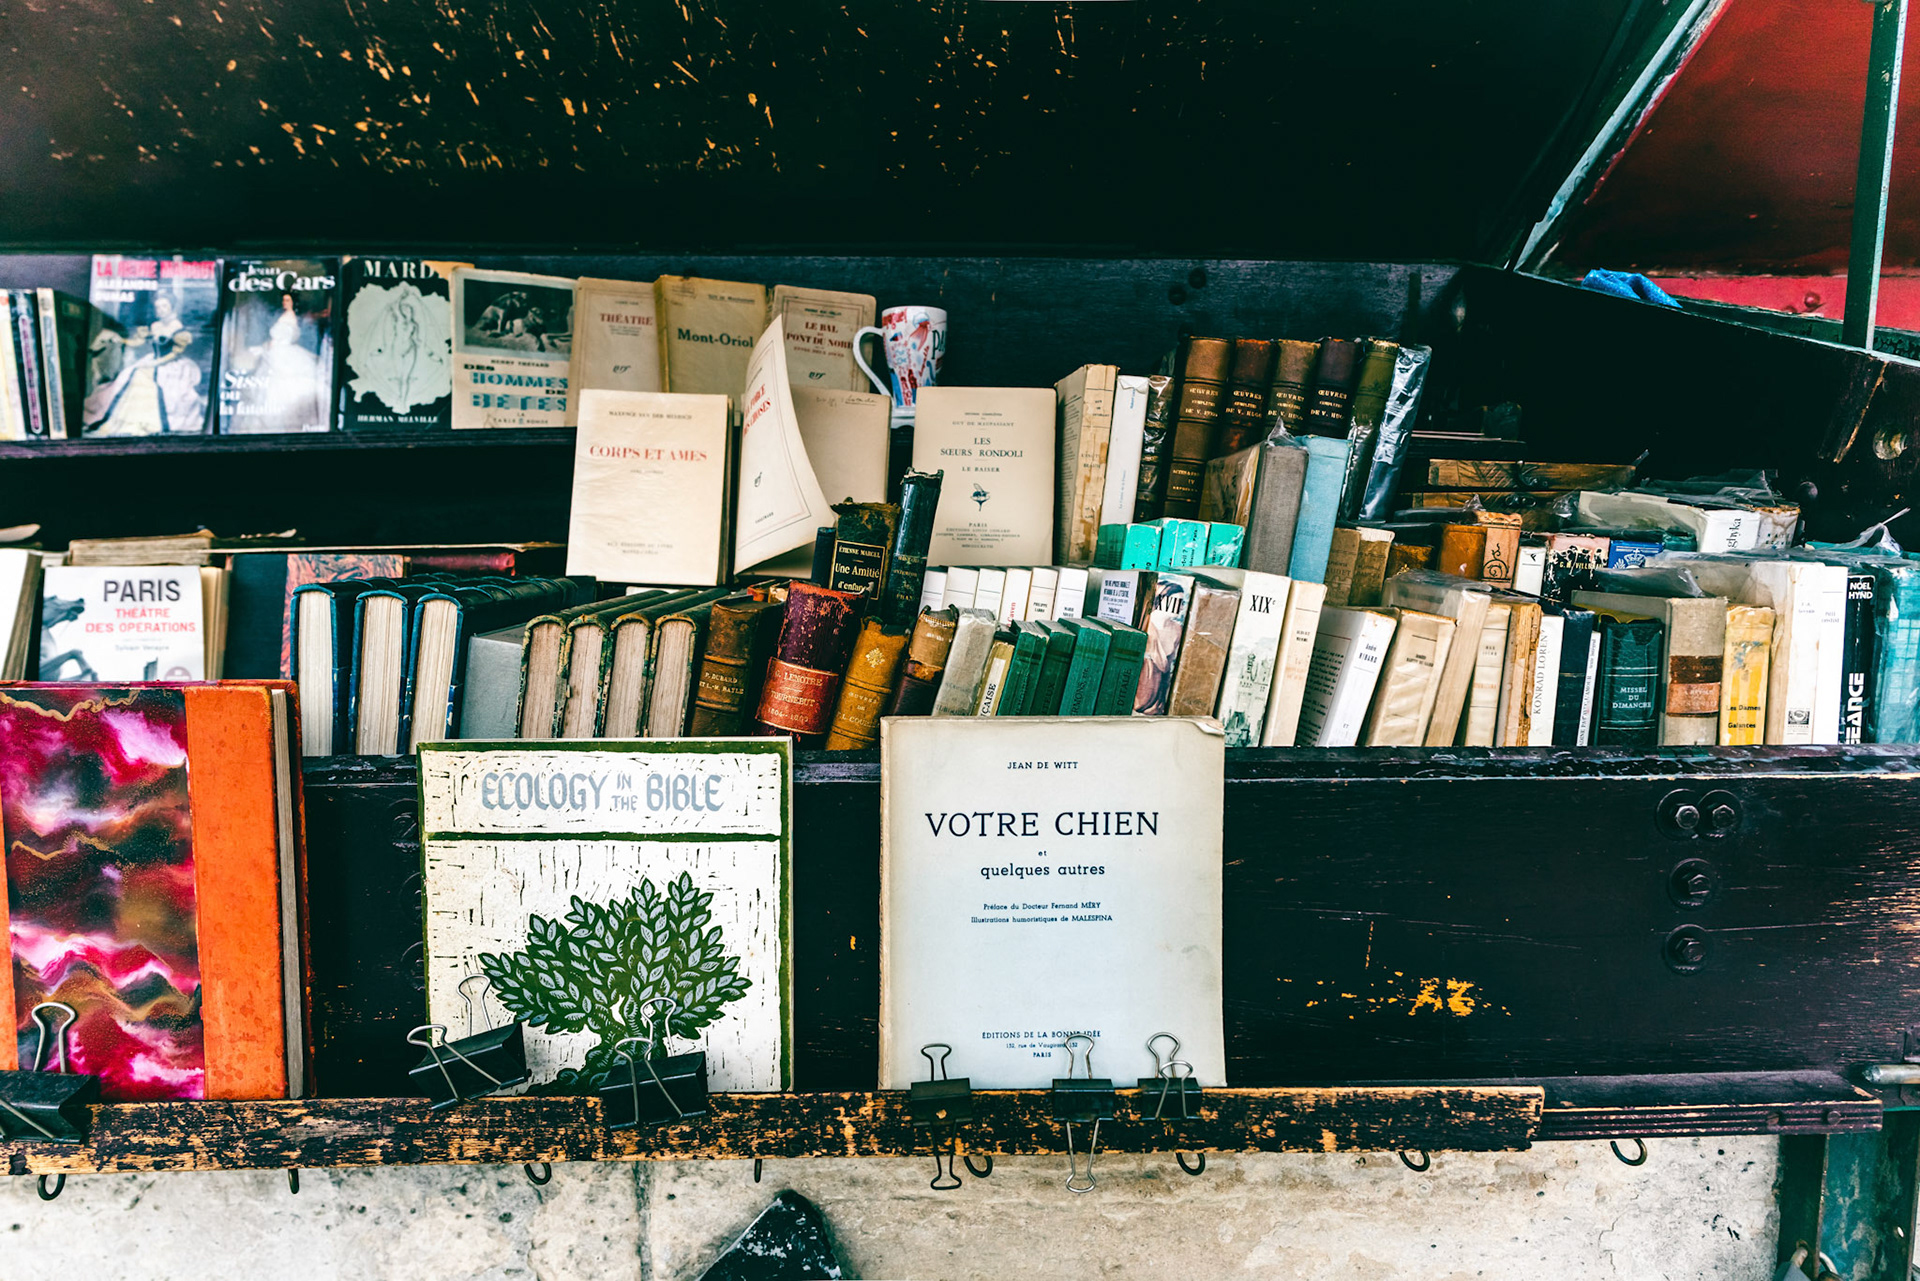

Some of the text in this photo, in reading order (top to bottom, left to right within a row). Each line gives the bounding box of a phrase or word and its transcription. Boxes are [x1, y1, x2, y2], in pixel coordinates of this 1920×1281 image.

[247, 264, 280, 276] Jean
[363, 260, 441, 279] MARD
[228, 271, 335, 292] des Cars
[677, 327, 754, 348] Mont-Oriol
[473, 372, 568, 389] HOMMES
[974, 437, 991, 446] LES
[589, 445, 640, 459] CORPS
[644, 448, 665, 461] ET
[940, 448, 1023, 458] SŒURS RONDOLI
[835, 563, 850, 574] Une
[852, 566, 880, 579] Amitié
[104, 579, 181, 602] PARIS
[1850, 582, 1872, 591] NOEL
[1848, 591, 1874, 600] HYND
[85, 622, 114, 633] DES
[784, 672, 823, 687] LENOTRE
[1118, 667, 1133, 707] D'ITALIE
[1533, 671, 1546, 714] KONRAD
[1620, 686, 1648, 694] MISSEL
[771, 690, 816, 707] TOURNEBUT
[1612, 701, 1652, 709] DIMANCHE
[1738, 704, 1761, 712] Dames
[1007, 761, 1079, 770] JEAN DE WITT
[482, 771, 725, 812] ECOLOGY IN THE BIBLE
[925, 811, 1159, 837] VOTRE CHIEN
[980, 863, 1105, 879] quelques autres
[983, 903, 1008, 911] Préface
[1012, 915, 1058, 924] humoristiques
[1071, 914, 1113, 922] MALESPINA
[981, 1030, 1021, 1039] ÉDITIONS
[1023, 1031, 1034, 1039] DE
